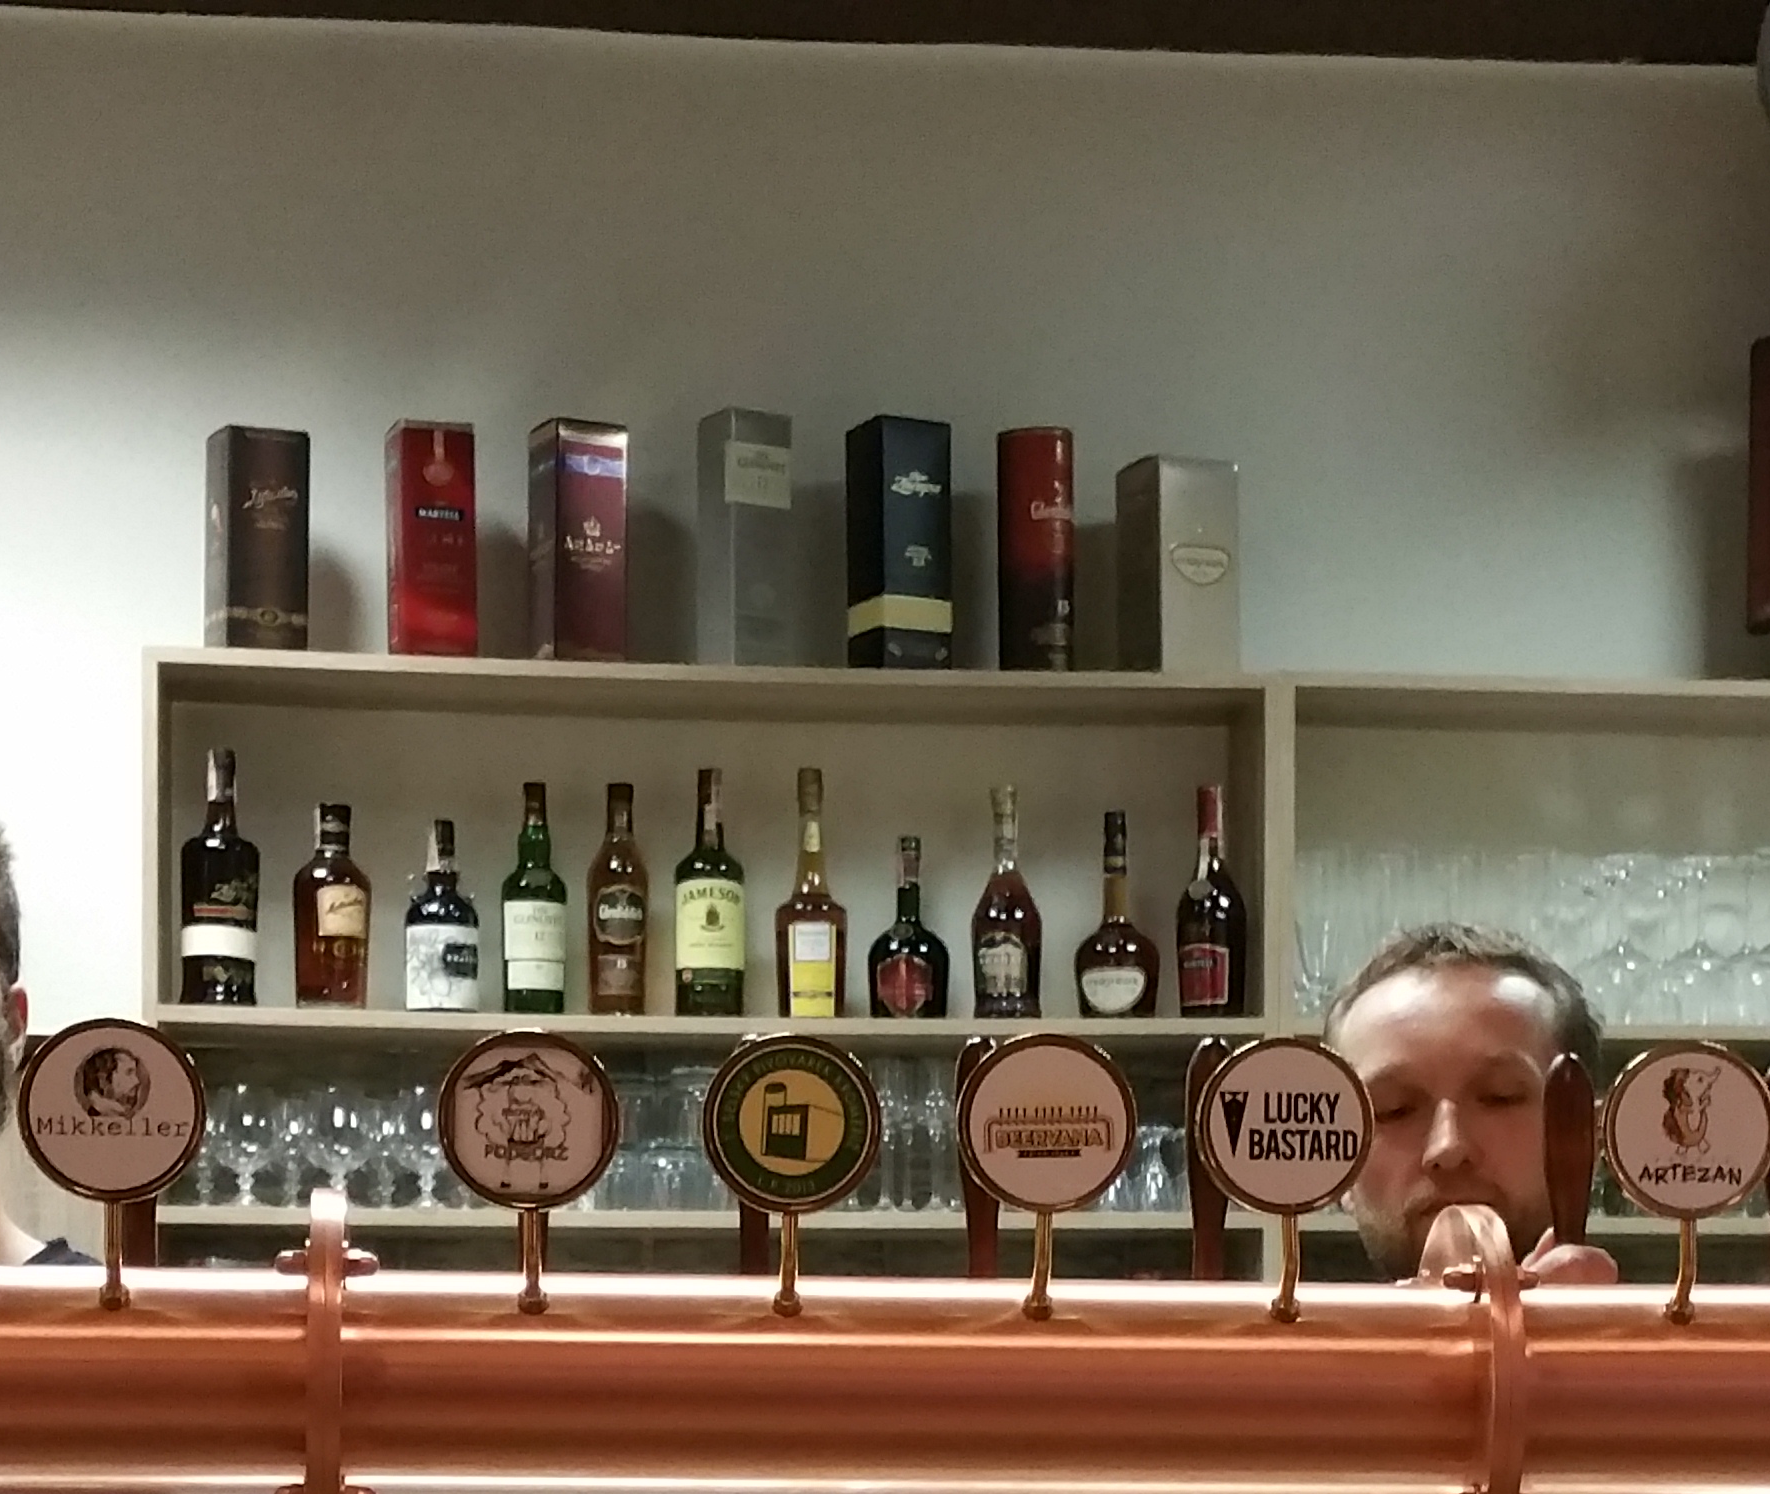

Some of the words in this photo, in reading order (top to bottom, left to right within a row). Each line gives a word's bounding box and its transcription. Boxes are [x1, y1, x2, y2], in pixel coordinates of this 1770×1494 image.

[1264, 1091, 1341, 1125] LUCKY
[36, 1115, 190, 1137] Mikkeller
[995, 1128, 1104, 1149] BEERVANA
[1249, 1129, 1359, 1161] BASTARD
[1639, 1162, 1742, 1186] ARTEZAN
